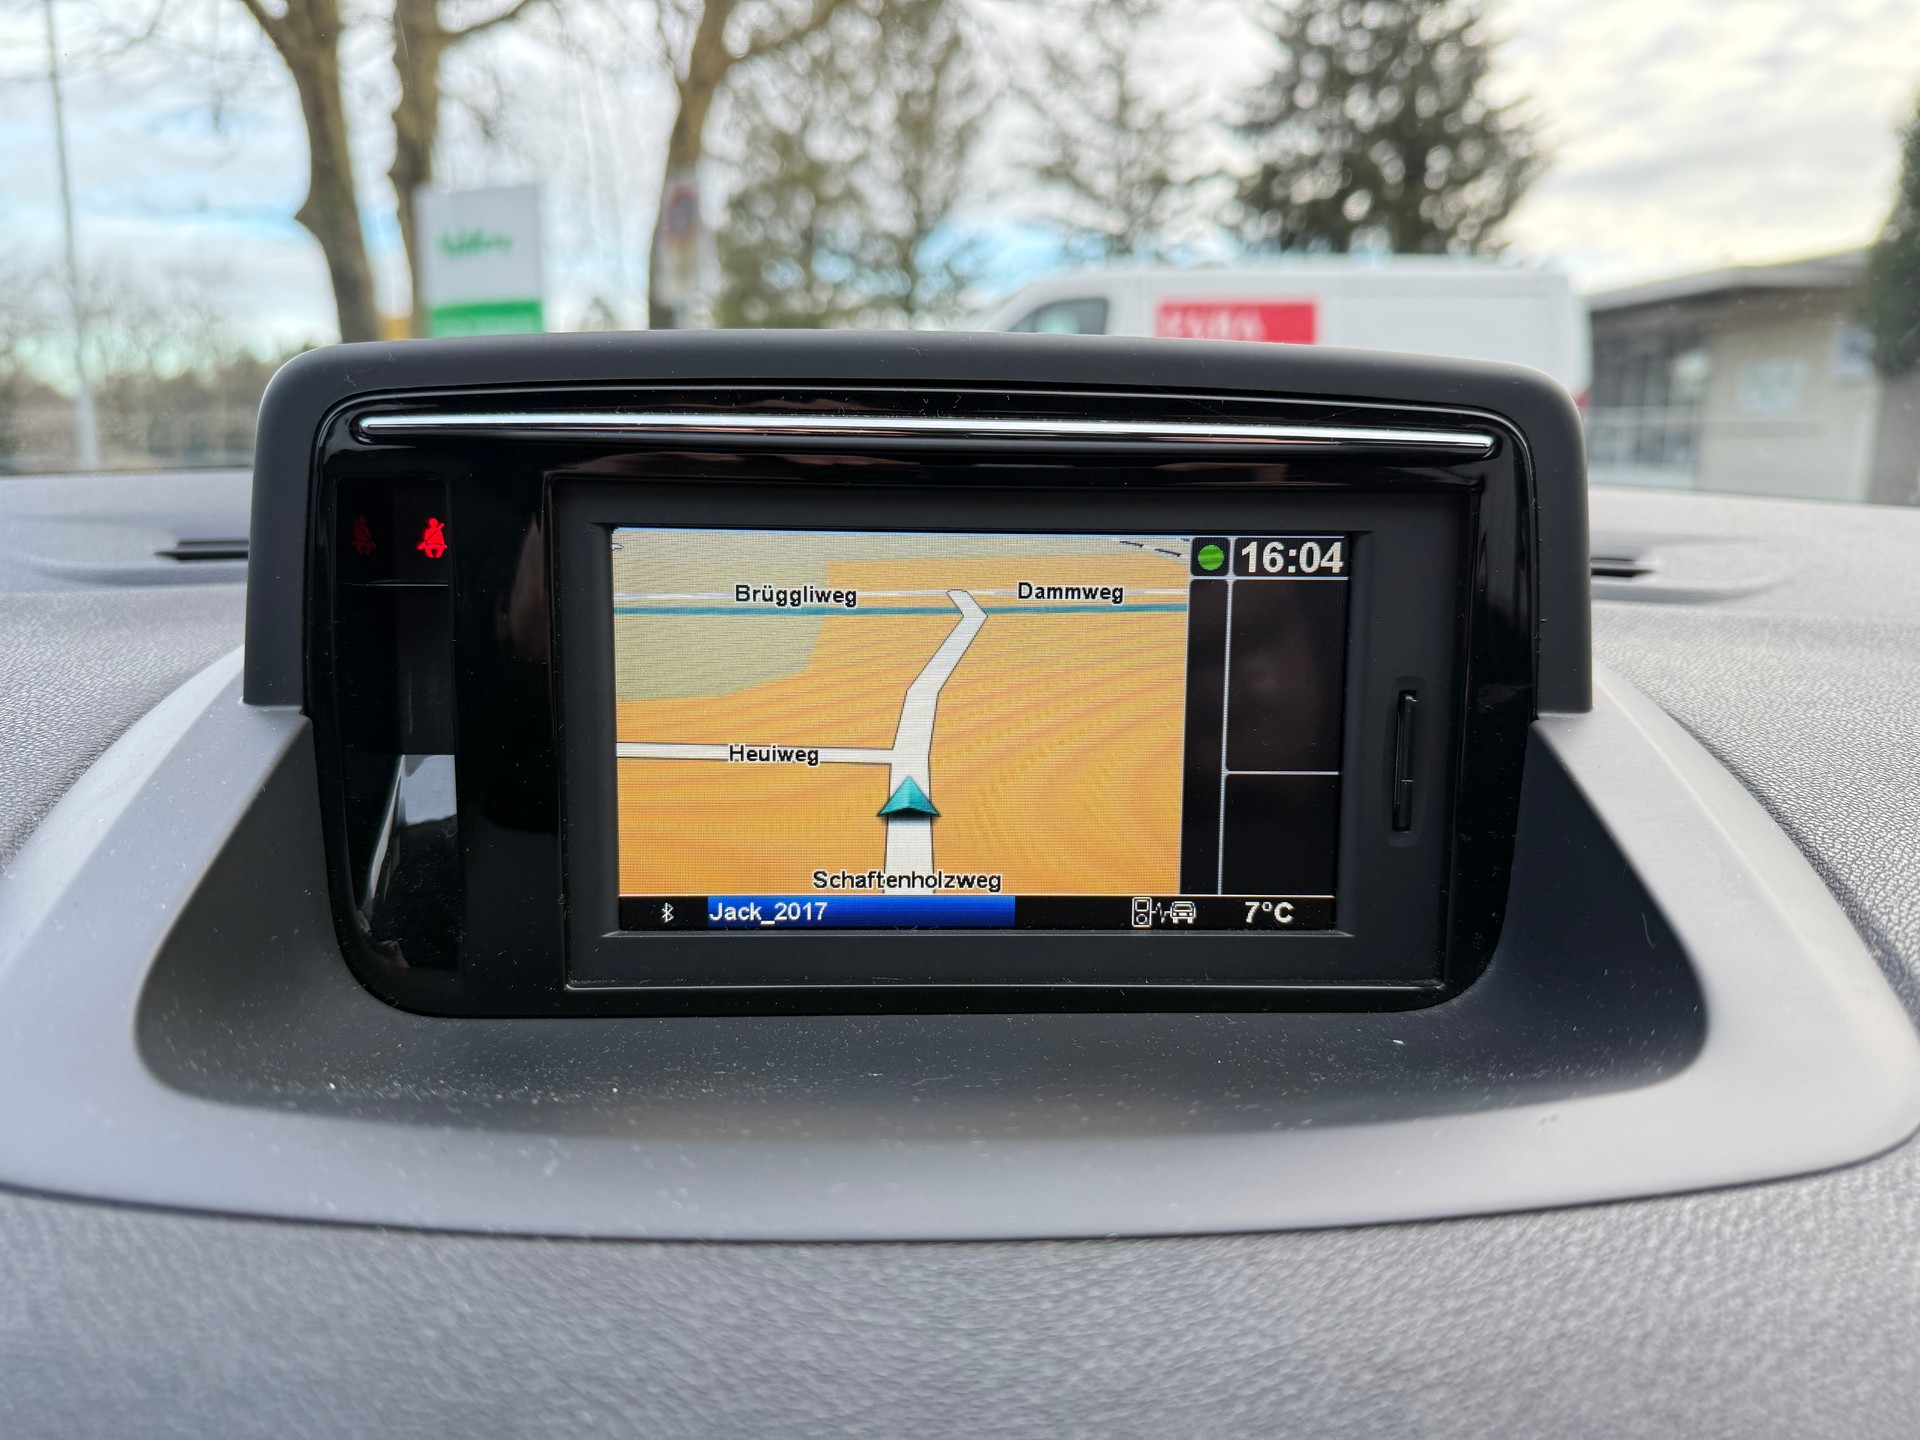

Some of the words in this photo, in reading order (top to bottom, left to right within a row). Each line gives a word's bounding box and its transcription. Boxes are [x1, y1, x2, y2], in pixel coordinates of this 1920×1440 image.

[1241, 541, 1344, 573] 16:04
[735, 585, 857, 606] Brüggliweg
[1018, 582, 1124, 603] Dammweg
[729, 745, 819, 765] Heuiweg
[813, 871, 1001, 892] Schaftenholzweg
[709, 902, 827, 925] Jack_2017
[1244, 901, 1294, 924] 7°C
